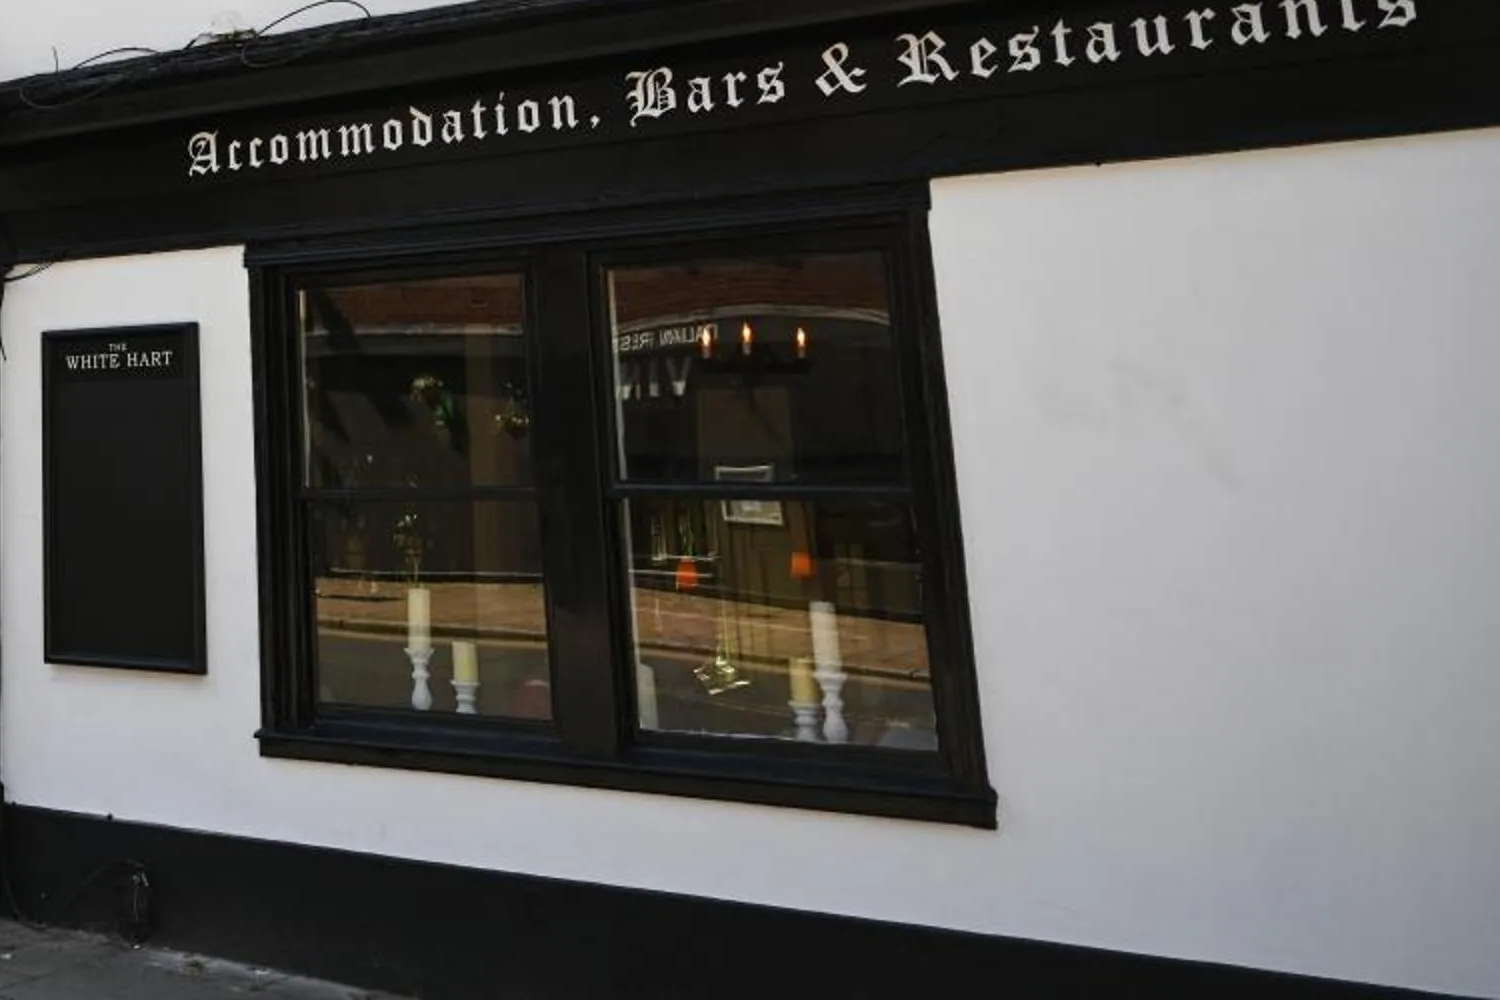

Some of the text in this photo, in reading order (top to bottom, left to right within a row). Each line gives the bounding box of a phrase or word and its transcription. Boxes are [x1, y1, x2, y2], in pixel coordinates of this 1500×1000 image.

[625, 62, 788, 128] Bars
[815, 41, 868, 98] &
[108, 342, 128, 352] THE
[65, 350, 173, 370] WHITE HART
